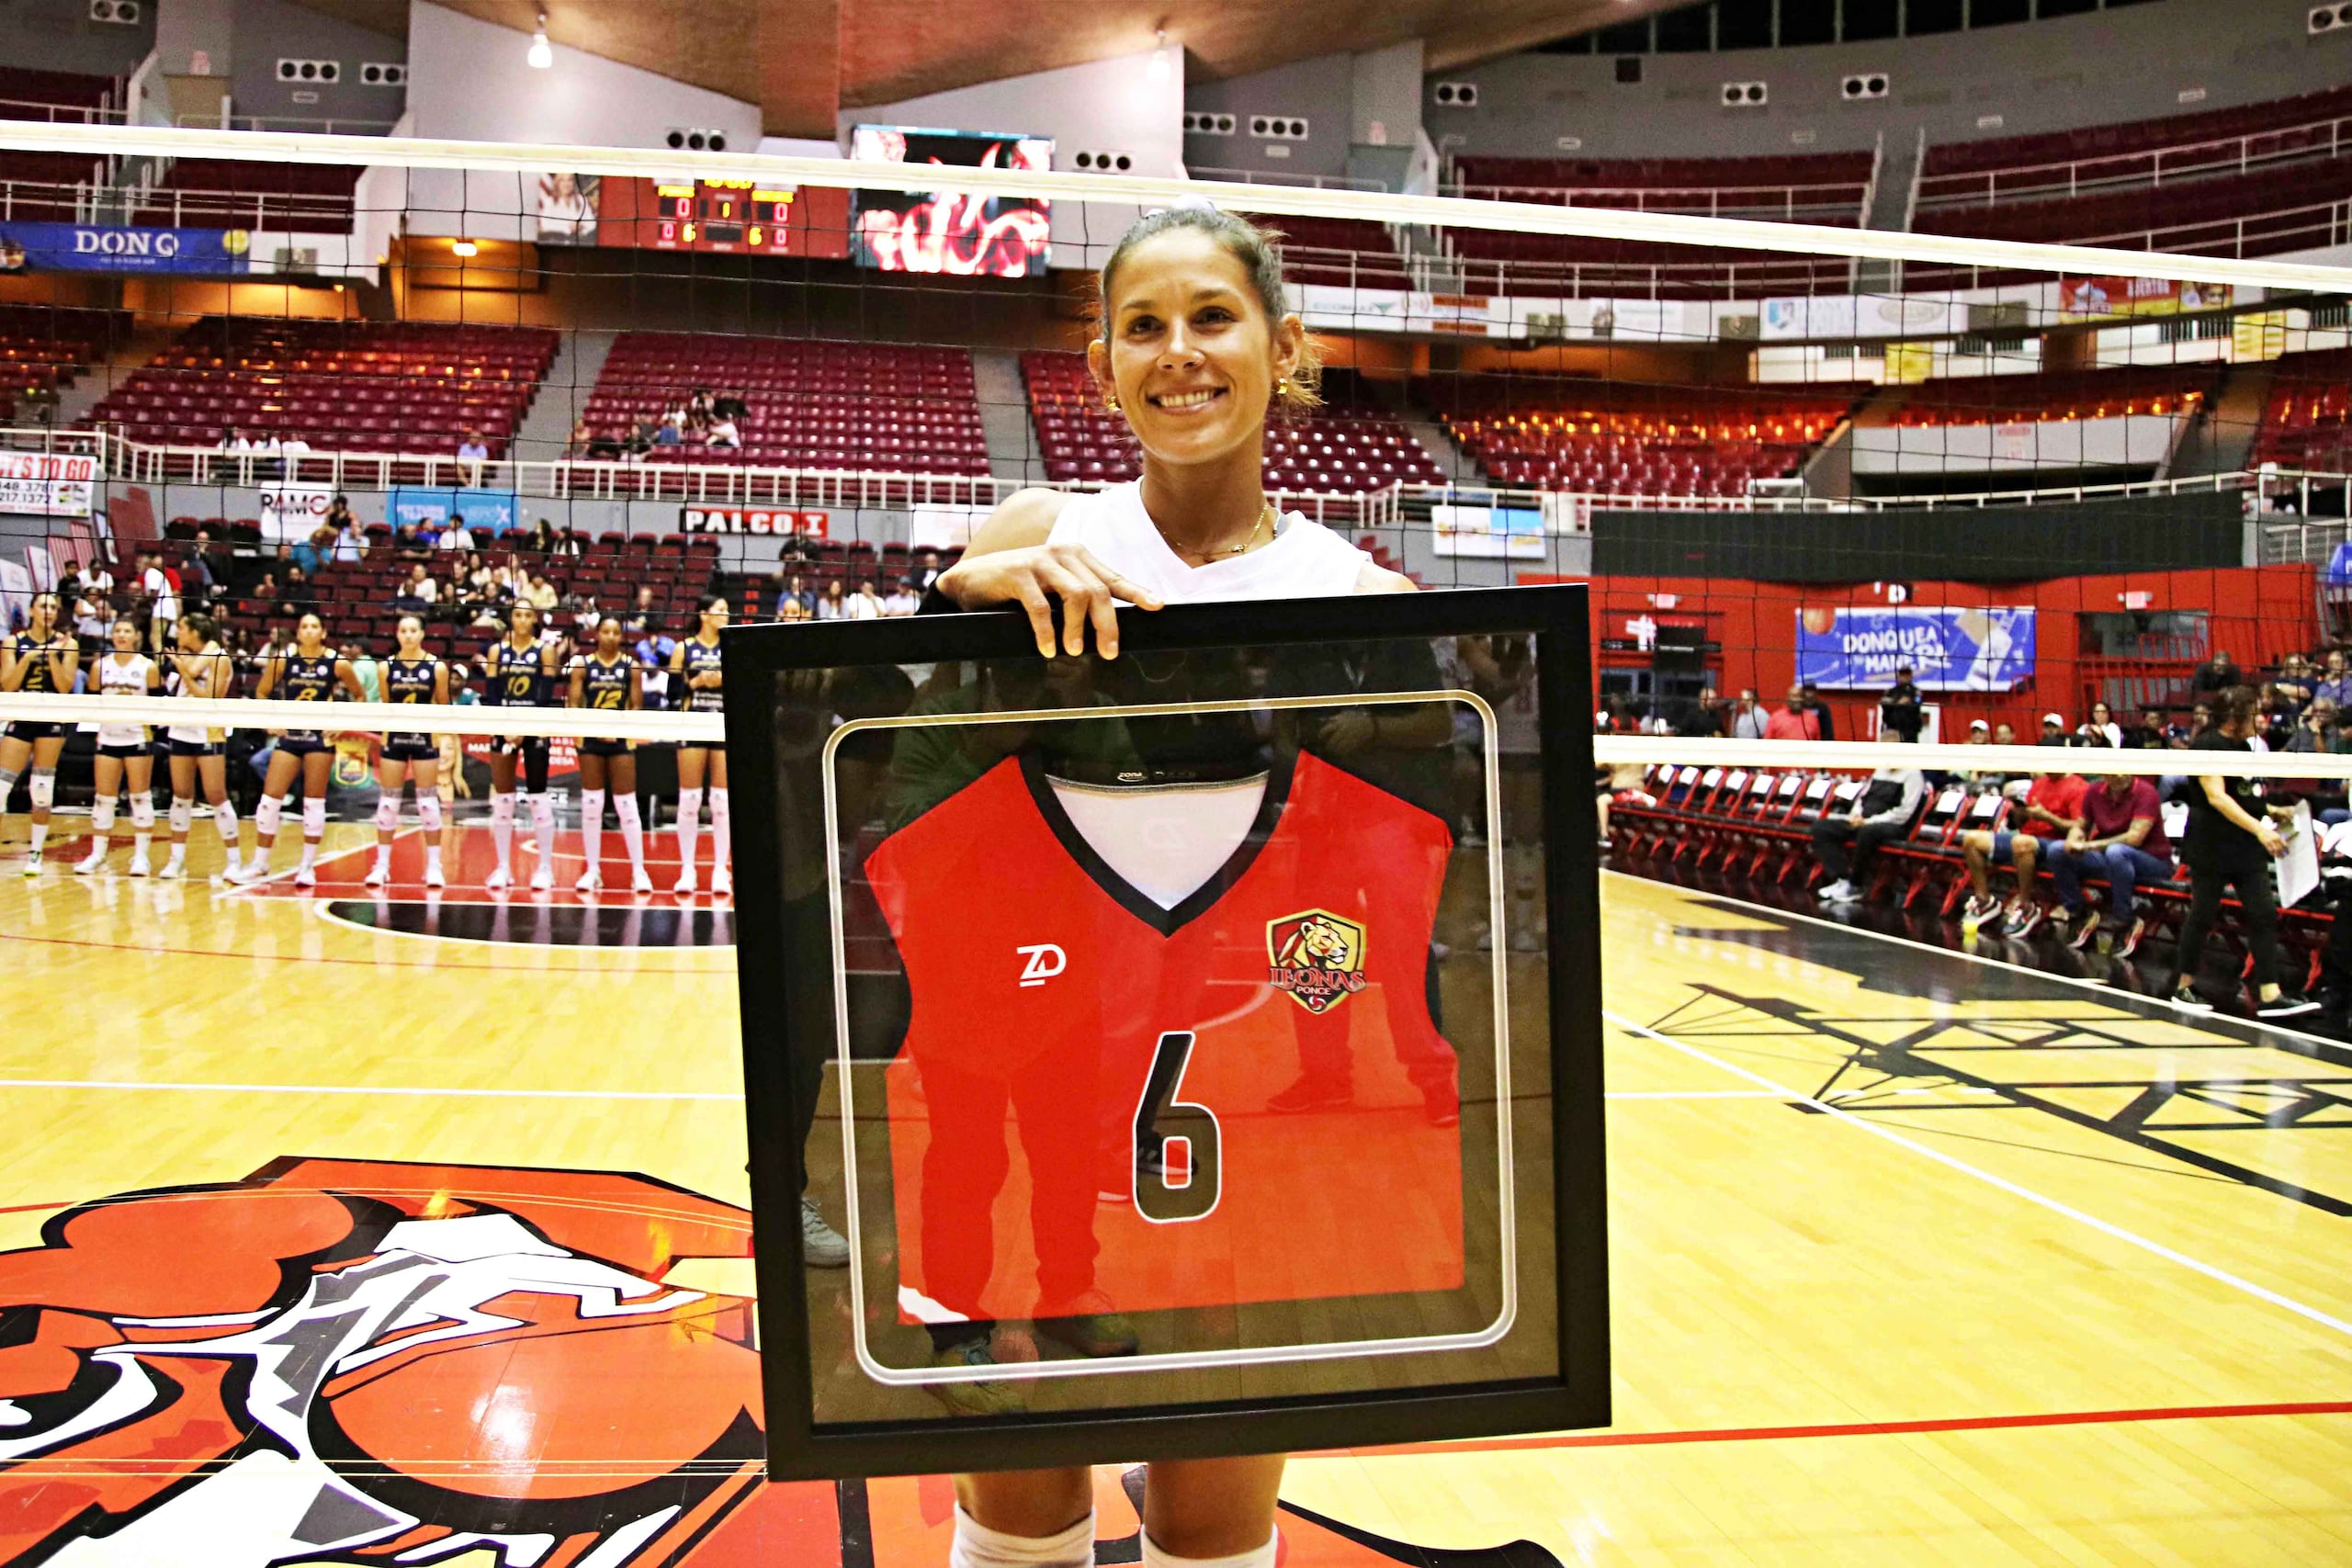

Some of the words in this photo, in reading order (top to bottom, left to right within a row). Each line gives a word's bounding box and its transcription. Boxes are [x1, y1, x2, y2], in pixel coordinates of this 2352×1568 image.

[74, 231, 152, 255] DON
[40, 457, 61, 479] TO
[65, 458, 91, 480] GO
[685, 511, 794, 535] PALCO
[507, 676, 530, 696] 10
[594, 690, 623, 708] 12
[1296, 986, 1331, 995] PONCE
[1133, 1030, 1221, 1224] 6
